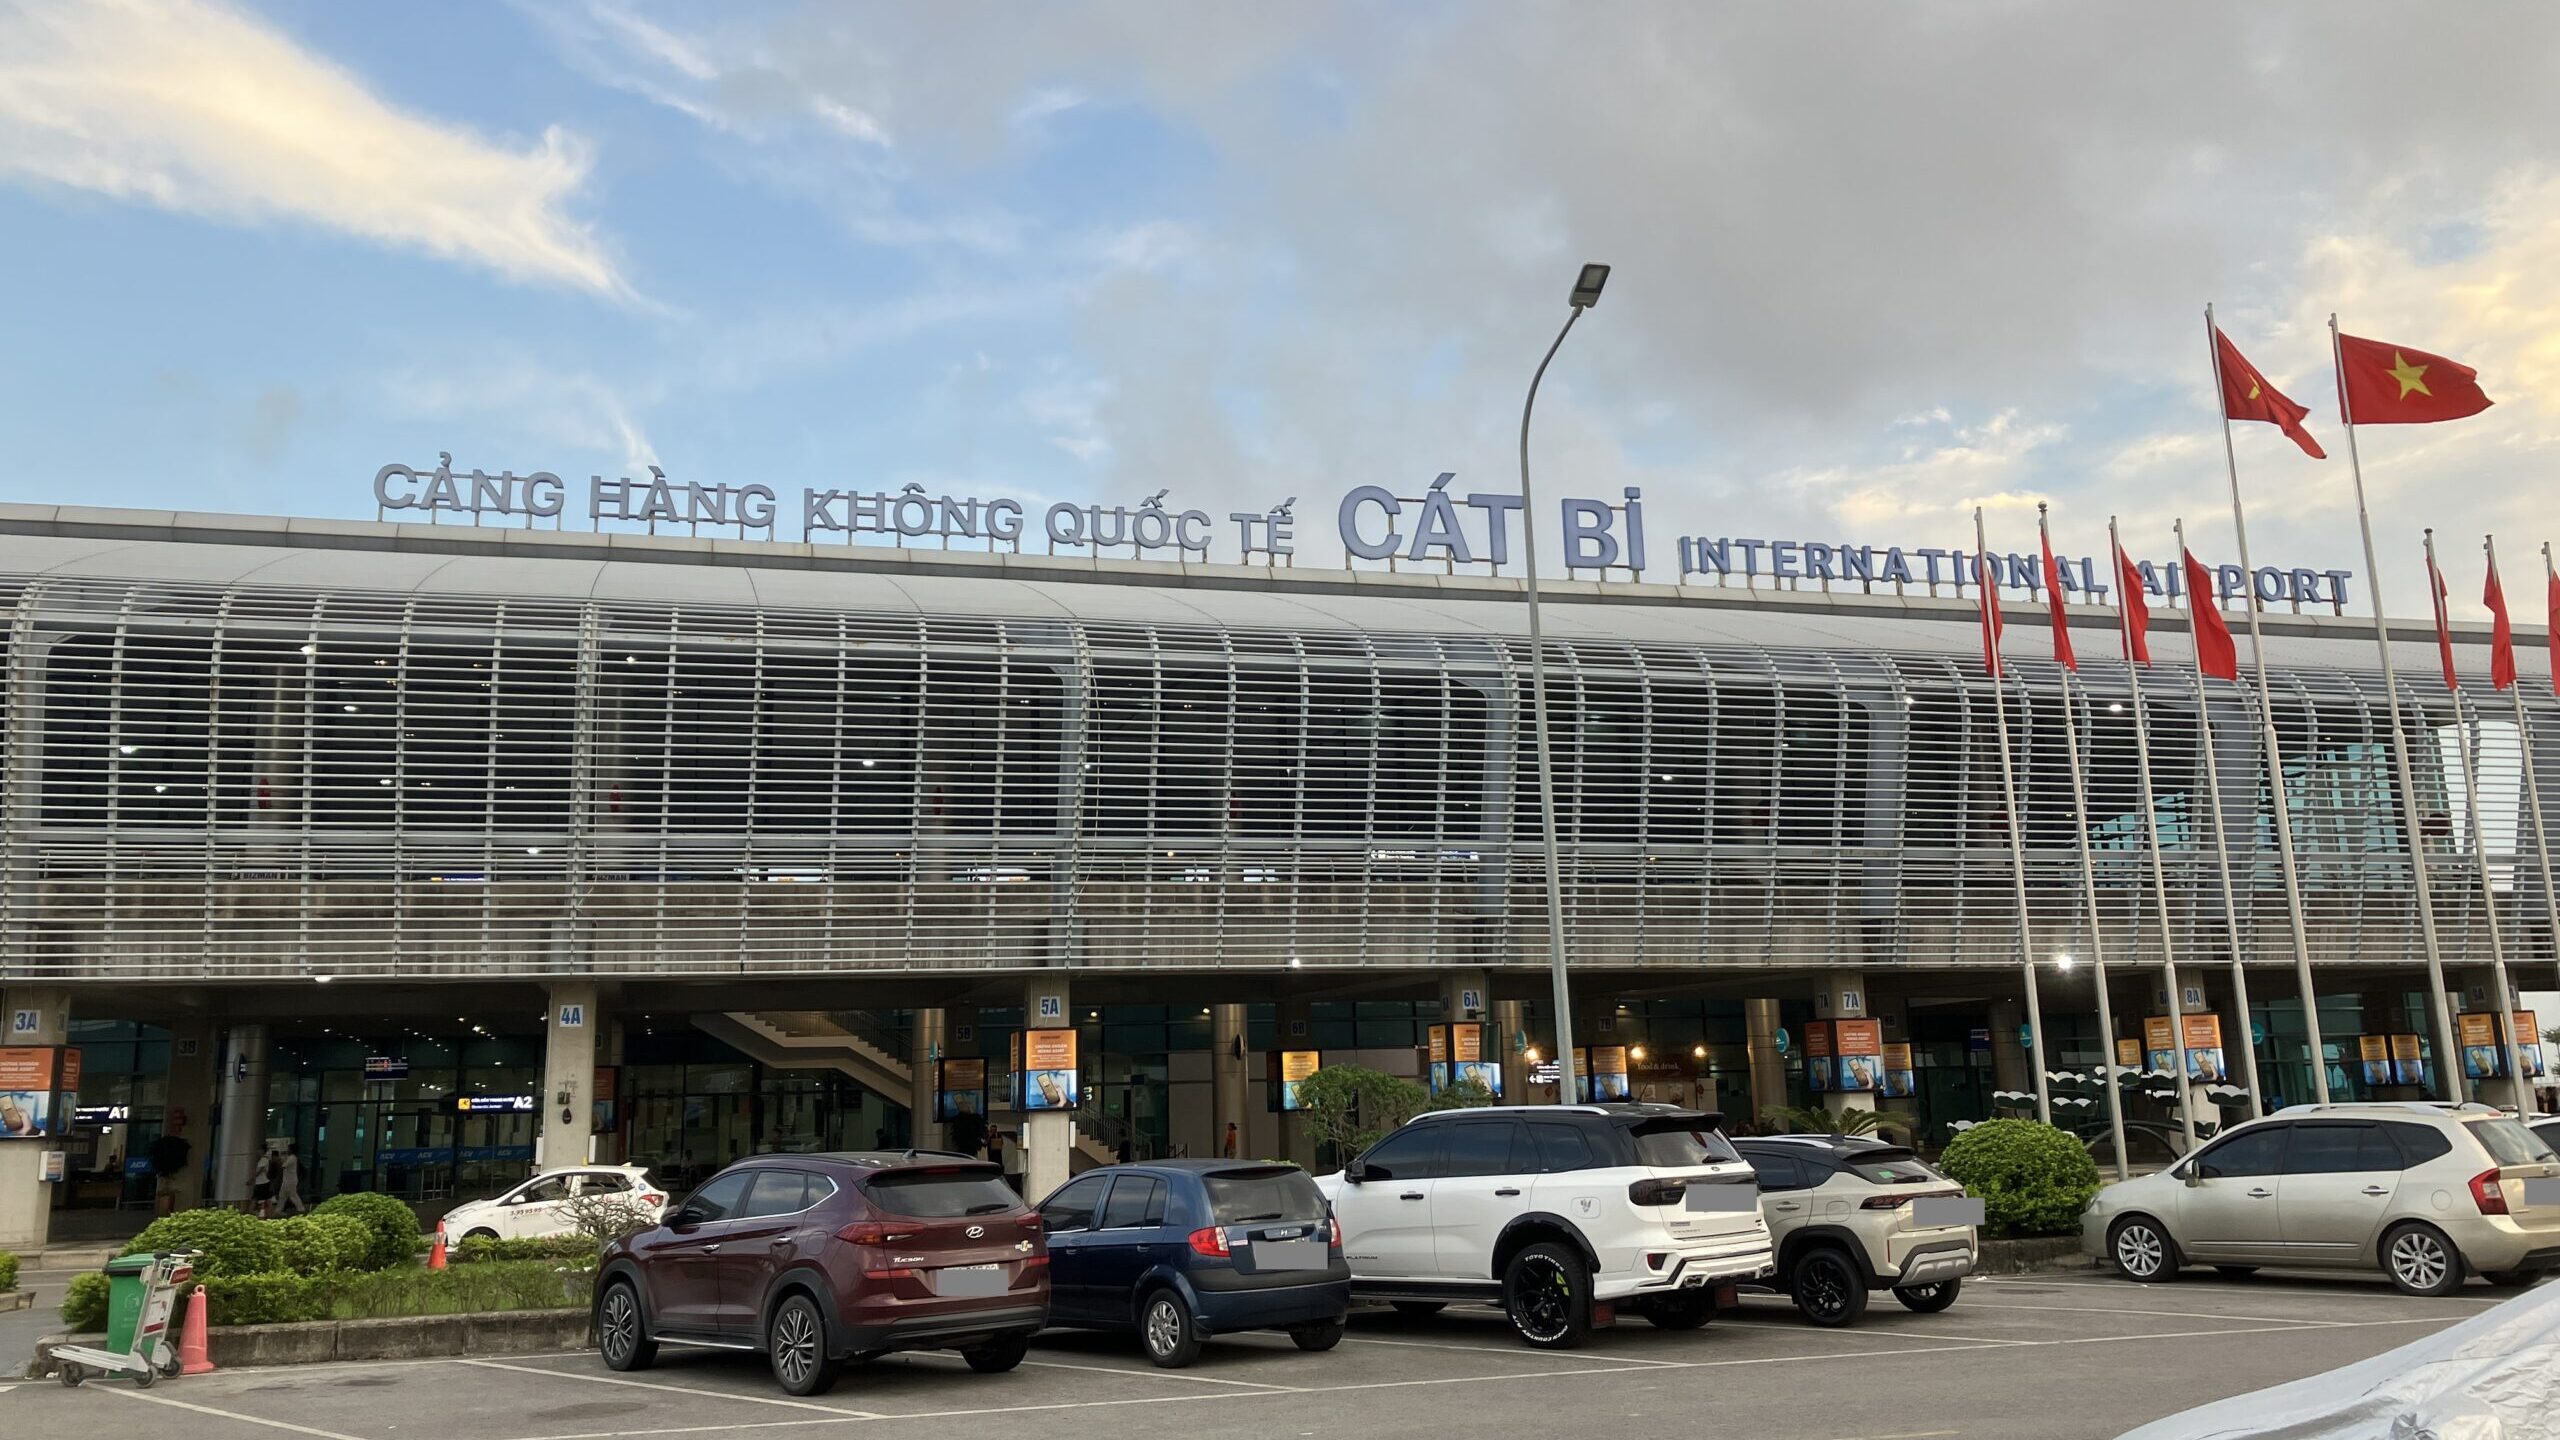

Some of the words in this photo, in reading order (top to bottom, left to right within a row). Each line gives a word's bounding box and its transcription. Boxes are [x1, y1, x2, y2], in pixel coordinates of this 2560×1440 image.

[374, 451, 564, 517] CẢNG
[589, 465, 775, 528] HÀNG
[804, 482, 1024, 540] KHÔNG
[1045, 489, 1212, 550] QUỐC
[1230, 496, 1297, 554] TẾ
[1339, 472, 1523, 564] CÁT
[1680, 535, 2108, 593] INTERNATIONAL
[2139, 560, 2352, 604] AIPORT
[1463, 992, 1480, 1008] 6A
[1819, 994, 1829, 1009] 7A
[1844, 993, 1859, 1008] 7A
[2187, 989, 2199, 1003] 8A
[1041, 998, 1059, 1015] 5A
[15, 1012, 38, 1030] 3A
[561, 1007, 582, 1025] 4A
[1637, 1062, 1653, 1071] food
[512, 1095, 533, 1109] A2
[108, 1106, 129, 1119] A1
[893, 1256, 925, 1264] TUCSON
[1525, 1254, 1544, 1263] TOYO
